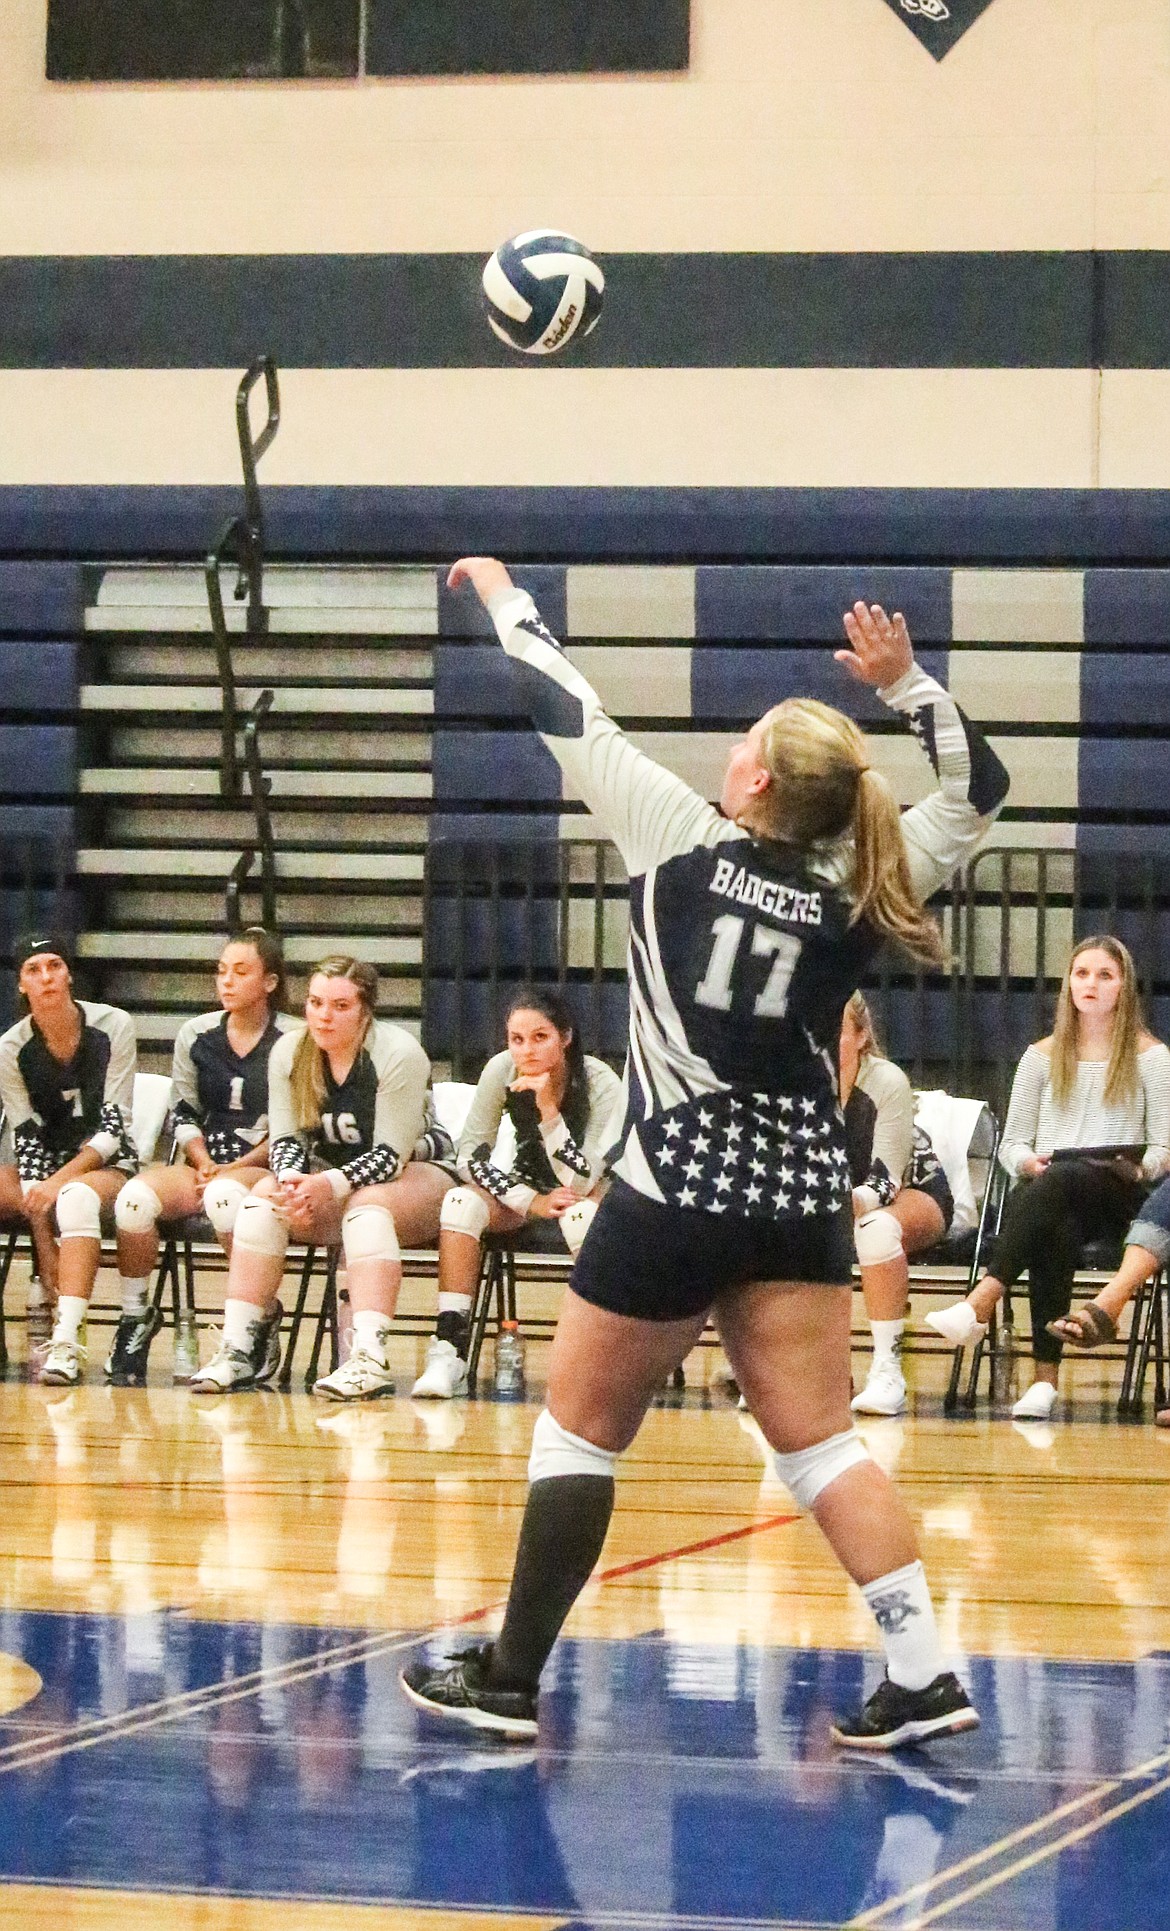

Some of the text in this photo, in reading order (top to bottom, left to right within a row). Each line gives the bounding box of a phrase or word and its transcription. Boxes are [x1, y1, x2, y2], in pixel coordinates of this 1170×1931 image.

[709, 858, 822, 925] BADGERS
[695, 914, 802, 1018] 17
[61, 1088, 83, 1117] 7
[229, 1076, 244, 1110] 1
[321, 1112, 361, 1144] 16
